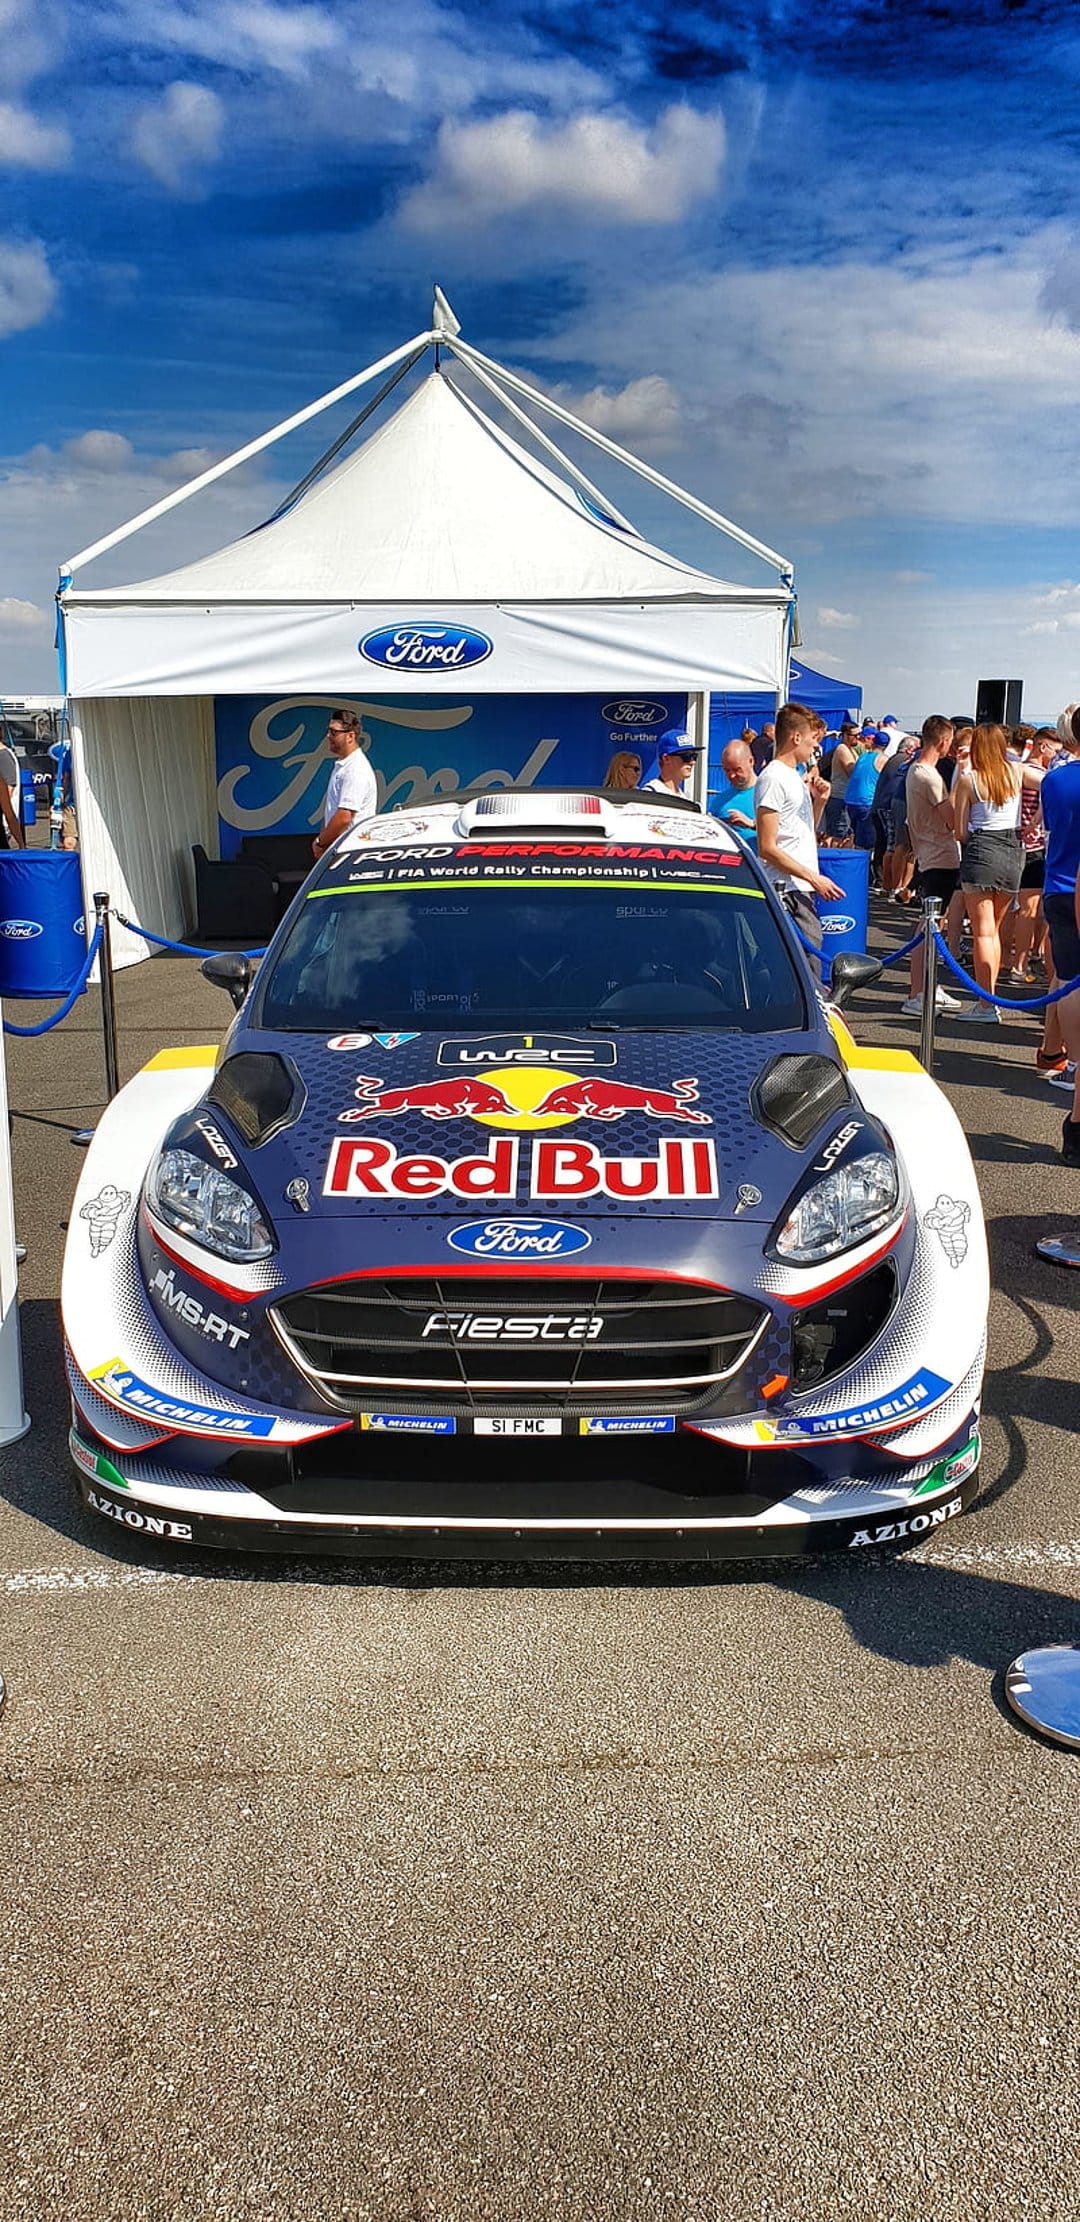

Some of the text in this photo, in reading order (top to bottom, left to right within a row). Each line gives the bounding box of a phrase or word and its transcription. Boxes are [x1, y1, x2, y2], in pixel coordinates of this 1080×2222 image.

[385, 628, 467, 664] Ford
[614, 702, 655, 722] Ford
[609, 732, 658, 742] Go Further
[353, 844, 744, 867] FORD PERFORMANCE
[397, 867, 426, 878] FIA
[430, 865, 479, 876] World
[484, 865, 526, 876] Rally
[531, 865, 649, 878] Championship
[4, 922, 33, 936] Ford
[522, 1035, 533, 1049] 1
[459, 1049, 595, 1063] WRC
[328, 1139, 715, 1197] Red Bull
[473, 1221, 565, 1253] Ford
[421, 1312, 604, 1339] Fiesta
[125, 1388, 254, 1430] MICHELIN
[812, 1383, 929, 1433] MICHELIN
[387, 1418, 447, 1430] MICHELIN
[513, 1419, 546, 1433] FMC
[606, 1419, 667, 1430] MICHELIN
[87, 1489, 193, 1540] AZIONE
[847, 1495, 963, 1548] AZIONE
